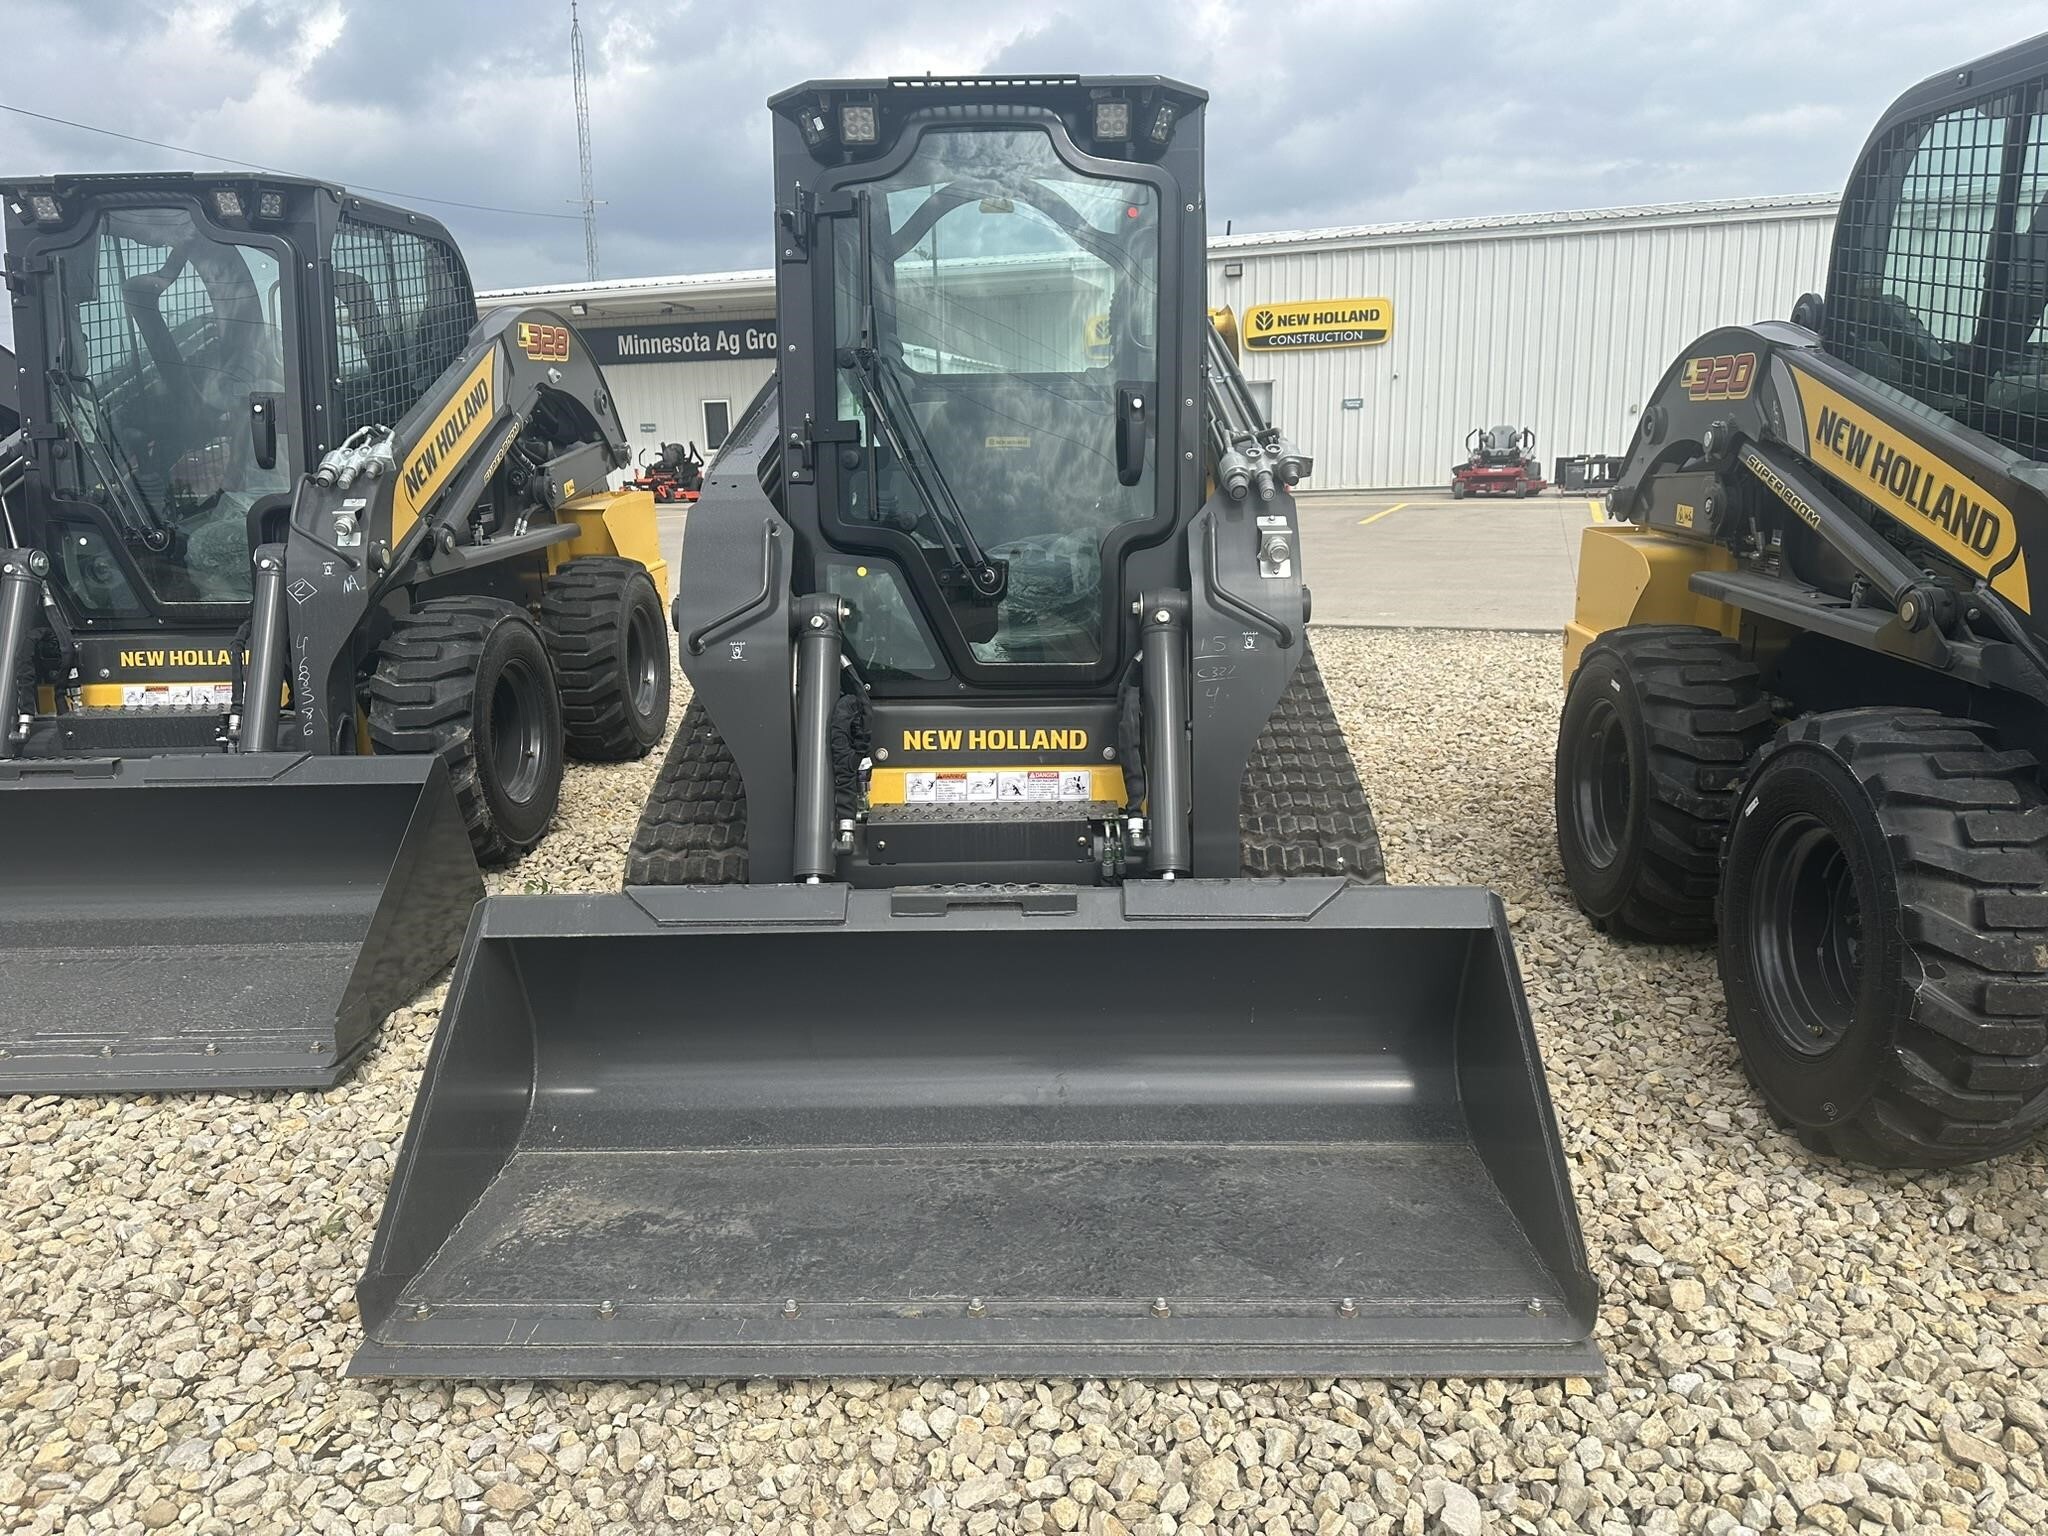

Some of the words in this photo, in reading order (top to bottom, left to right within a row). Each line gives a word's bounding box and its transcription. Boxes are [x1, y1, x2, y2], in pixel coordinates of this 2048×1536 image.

[1278, 313, 1310, 327] NEW
[1313, 308, 1380, 325] HOLLAND
[518, 322, 570, 362] L328
[618, 331, 711, 356] Minnesota
[716, 330, 741, 356] Ag
[745, 328, 777, 350] Gro
[1268, 331, 1363, 345] CONSTRUCTION
[1681, 352, 1757, 401] L320
[405, 442, 437, 499] NEW
[436, 377, 489, 460] HOLLAND
[1815, 405, 1873, 470] NEW
[1869, 440, 2001, 559] HOLLAND
[294, 581, 306, 597] 2
[1200, 635, 1228, 653] 15
[120, 649, 165, 667] NEW
[903, 729, 963, 751] NEW
[968, 729, 1088, 751] HOLLAND
